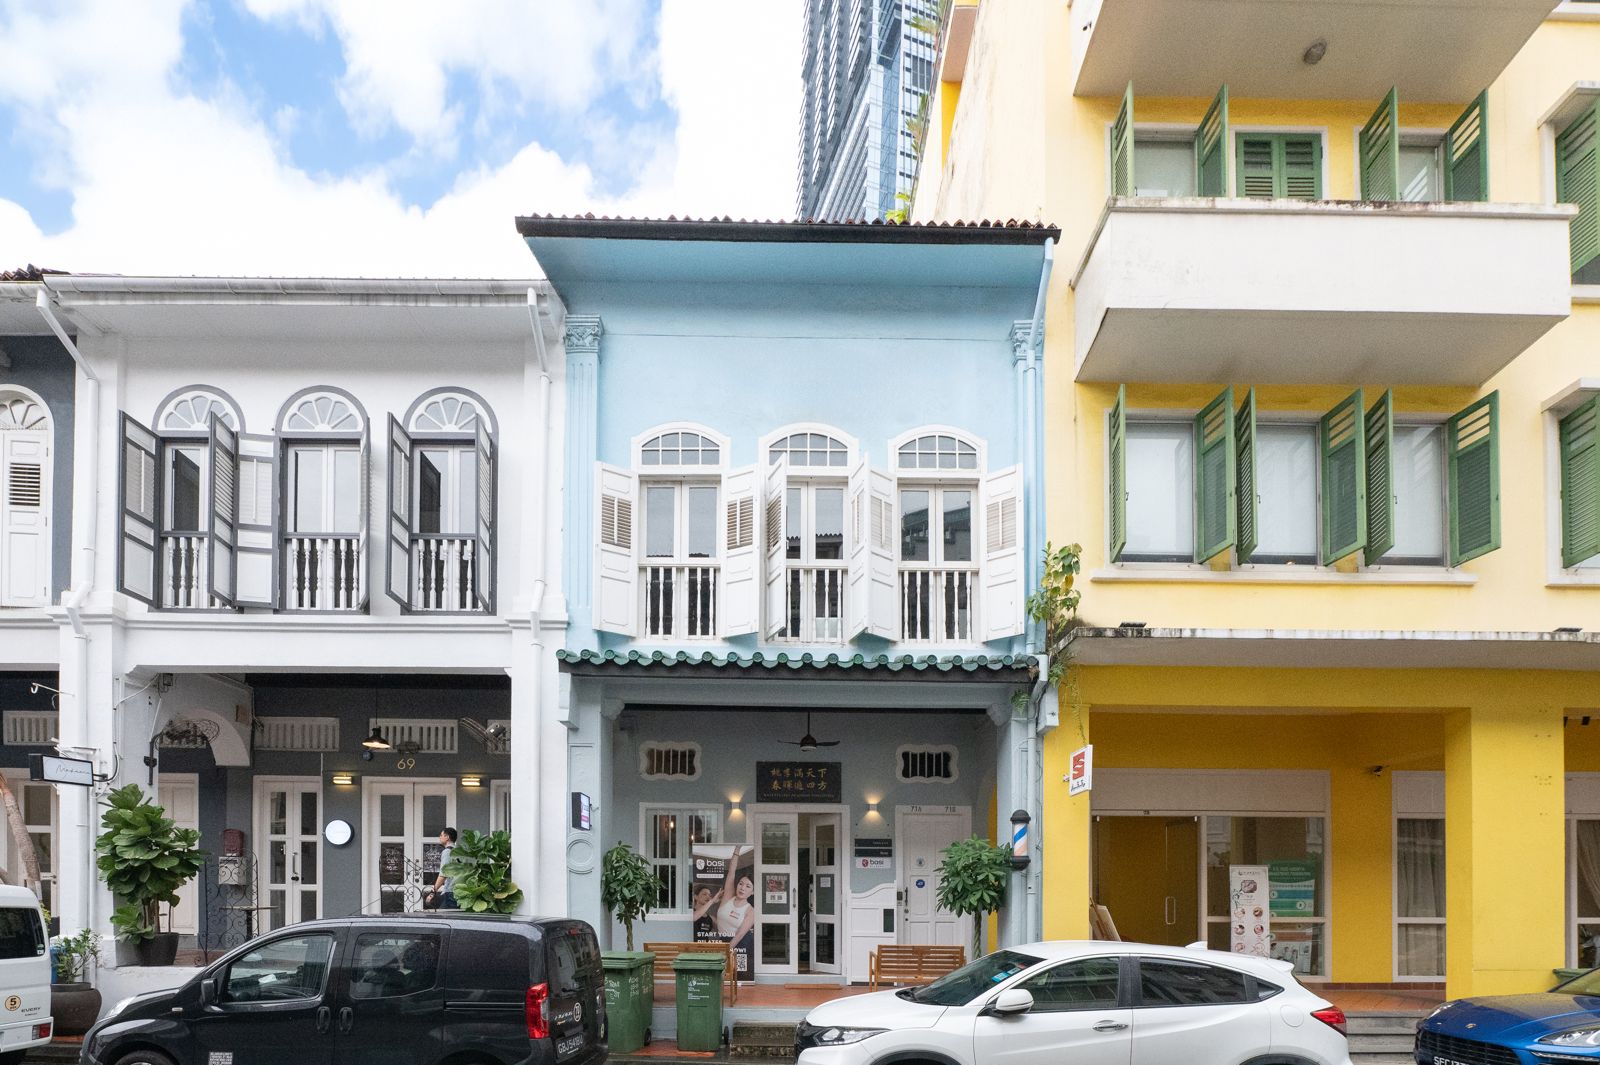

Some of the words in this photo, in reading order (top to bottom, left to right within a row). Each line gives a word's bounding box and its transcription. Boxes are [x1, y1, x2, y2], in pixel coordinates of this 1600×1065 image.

[397, 758, 416, 770] 69
[706, 859, 725, 867] basi
[10, 997, 17, 1006] 5
